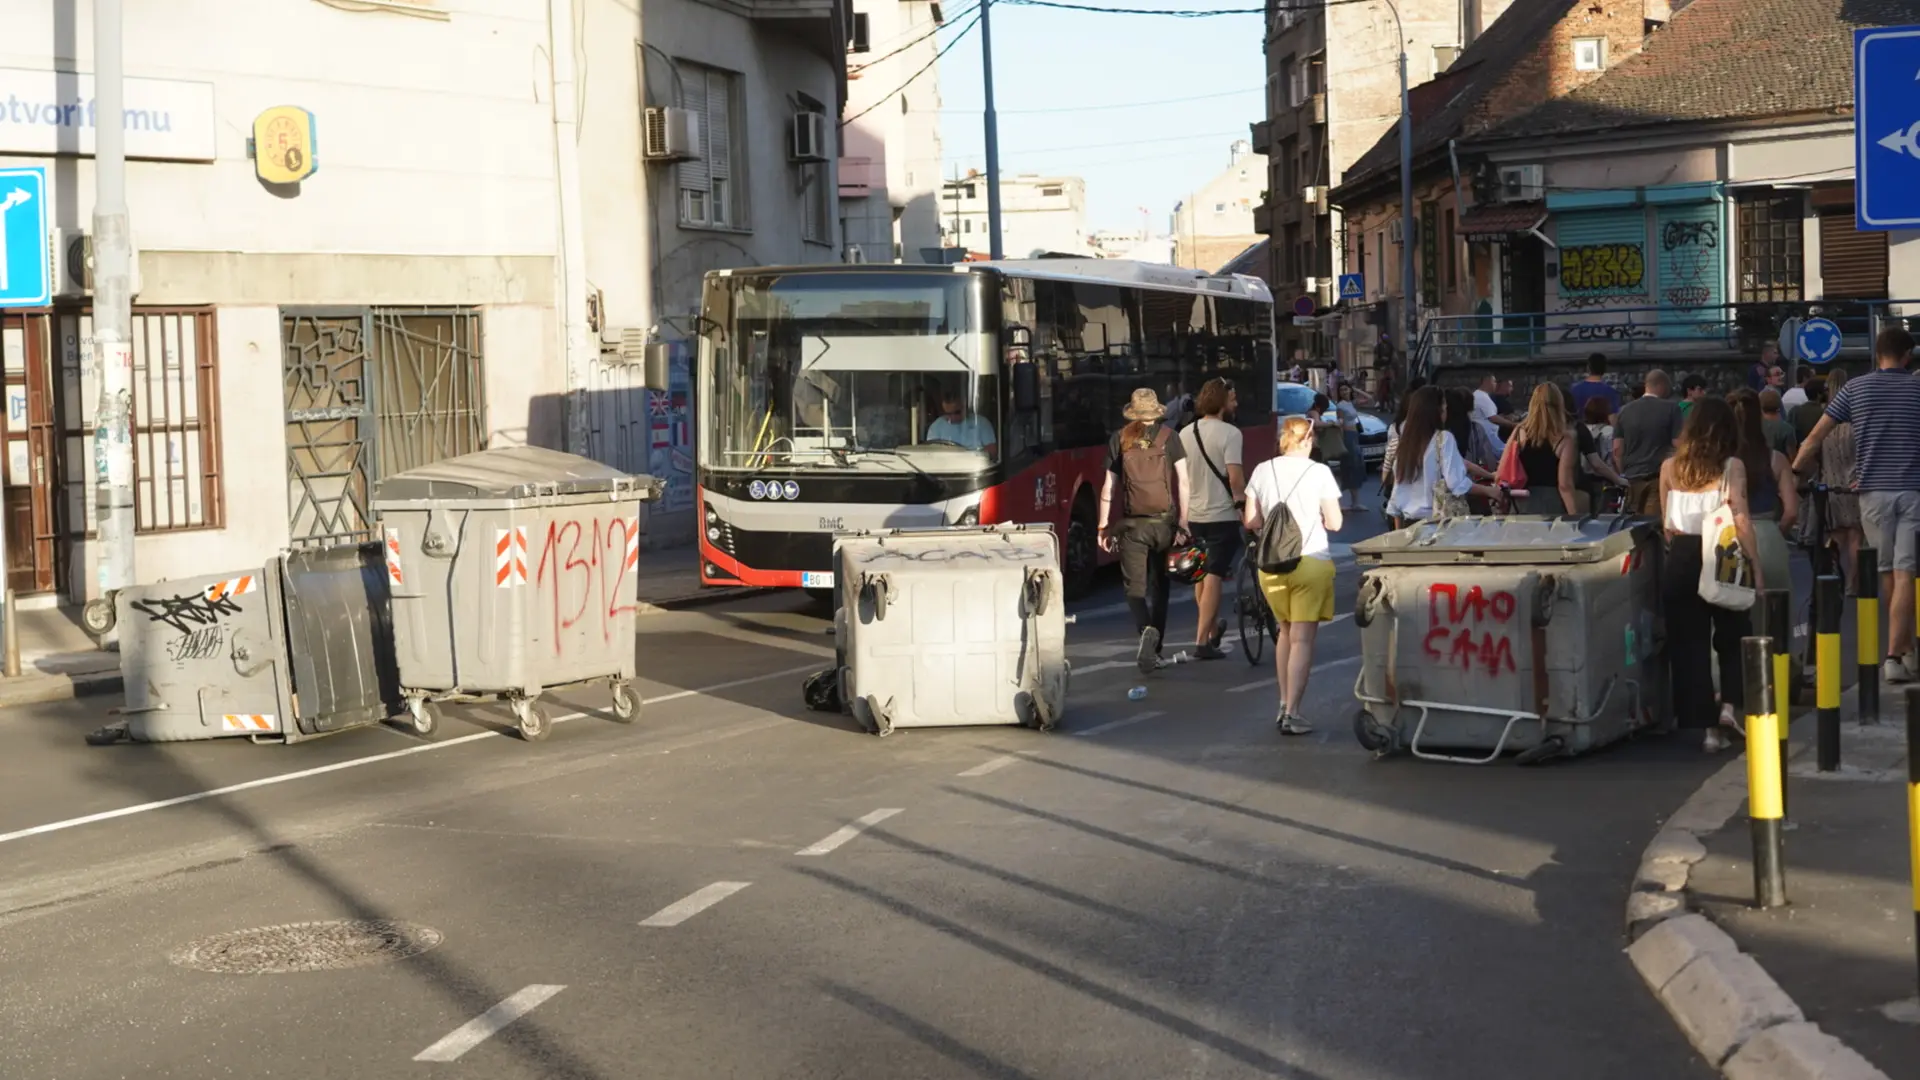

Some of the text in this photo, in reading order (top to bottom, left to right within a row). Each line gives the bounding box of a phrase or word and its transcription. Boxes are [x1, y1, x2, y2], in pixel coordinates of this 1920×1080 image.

[819, 517, 844, 529] BMC
[860, 547, 1046, 563] ACAB
[537, 517, 637, 655] 1312
[809, 574, 821, 585] BG
